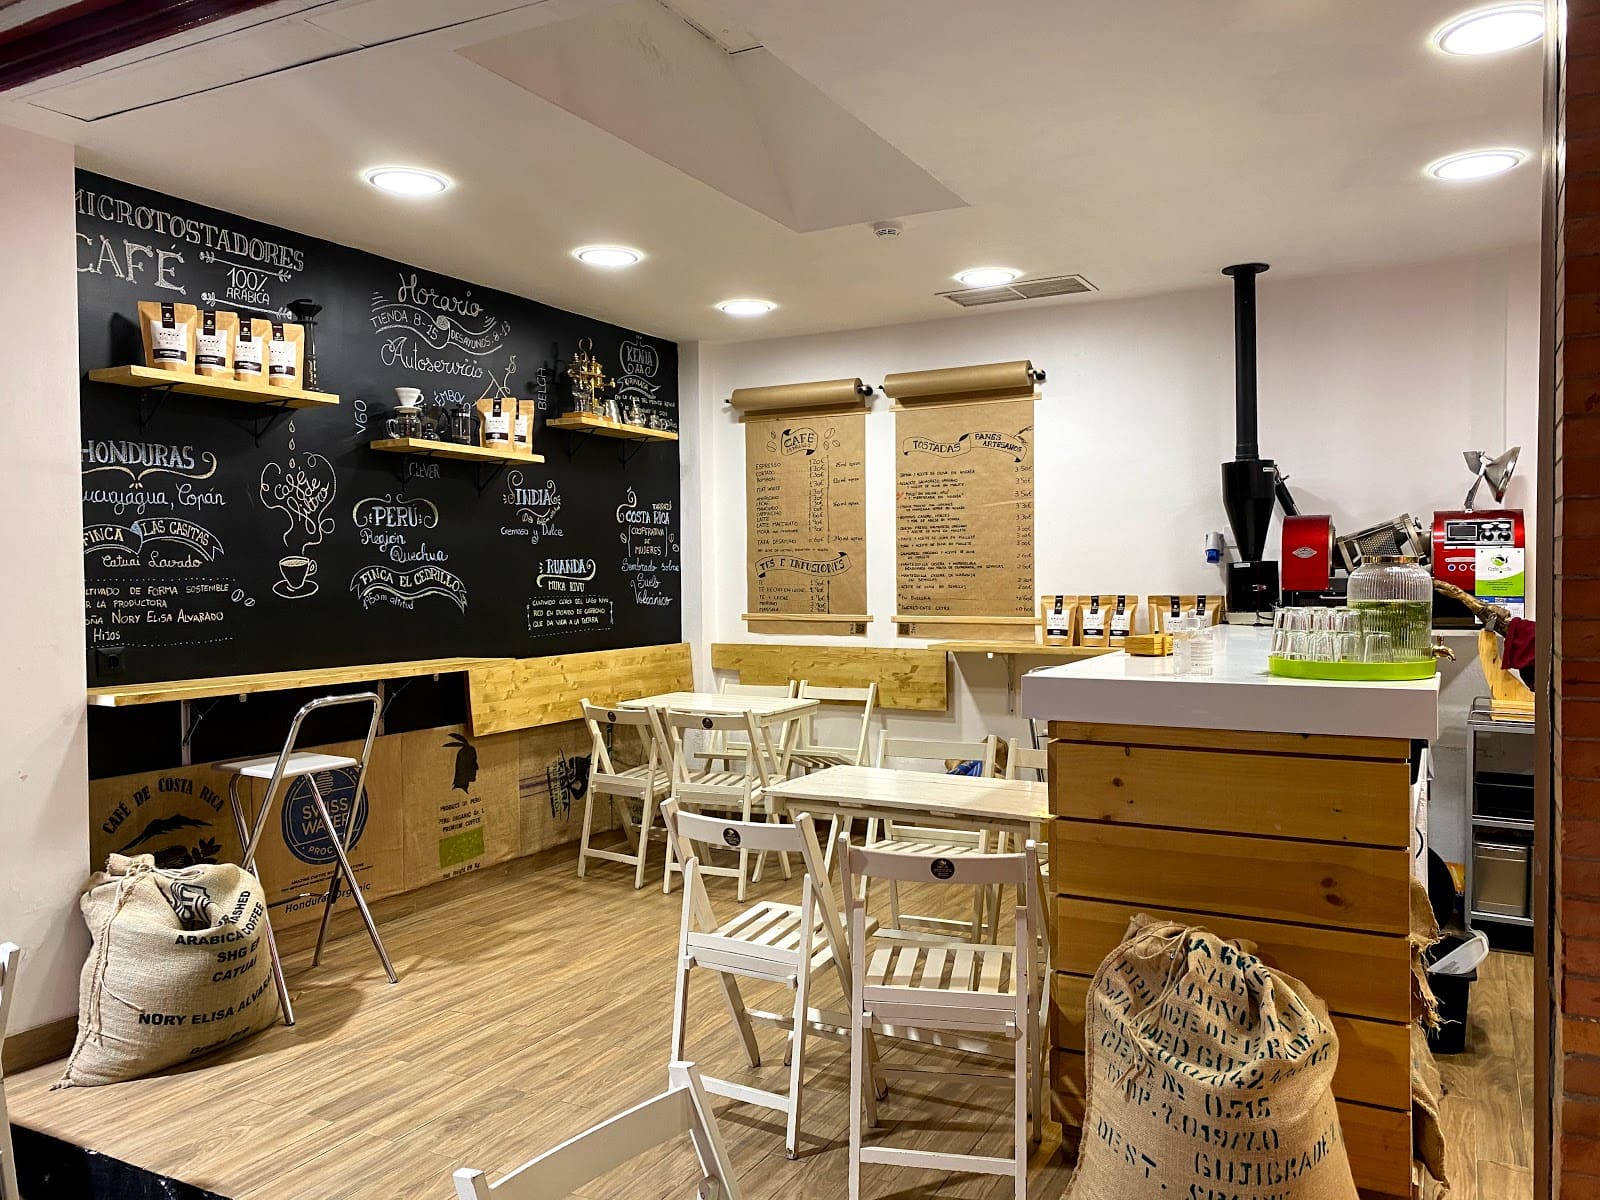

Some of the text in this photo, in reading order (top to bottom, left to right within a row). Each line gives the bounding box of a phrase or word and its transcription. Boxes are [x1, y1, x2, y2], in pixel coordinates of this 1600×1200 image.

[226, 267, 268, 292] 100%
[398, 273, 484, 317] Horario
[370, 310, 408, 327] TIENDA
[380, 337, 484, 378] Autoservicio
[626, 345, 653, 366] KENIA
[537, 367, 547, 411] BELGA
[353, 399, 368, 434] V60
[912, 440, 960, 452] TOSTADAS
[974, 433, 1002, 441] PANES
[982, 440, 1023, 452] ARTESANOS
[81, 440, 195, 469] HONDURAS
[409, 462, 440, 479] CLEVER
[514, 488, 551, 506] INDIA
[625, 510, 670, 525] COSTA RICA
[83, 521, 209, 547] FINCA LAS CASITAS
[542, 523, 564, 537] Dulce
[389, 543, 449, 563] Quechua
[634, 545, 661, 556] MUJERES
[545, 559, 587, 574] RUANDA
[790, 559, 844, 573] INFUSIONES
[359, 567, 460, 591] FINCA EL CEDRILLO
[129, 587, 142, 595] DE
[147, 585, 178, 596] FORMA
[185, 583, 230, 593] SOSTENIBLE
[97, 600, 107, 608] LA
[113, 599, 167, 608] PRODUCTORA
[102, 777, 225, 835] CAFÉ DE COSTA RICA
[302, 814, 349, 836] WAER
[285, 894, 329, 914] Hondura
[175, 902, 264, 946] ARABICA COFFEE
[217, 947, 247, 963] SHG
[138, 1012, 186, 1026] NORY
[191, 1006, 234, 1025] ELISA
